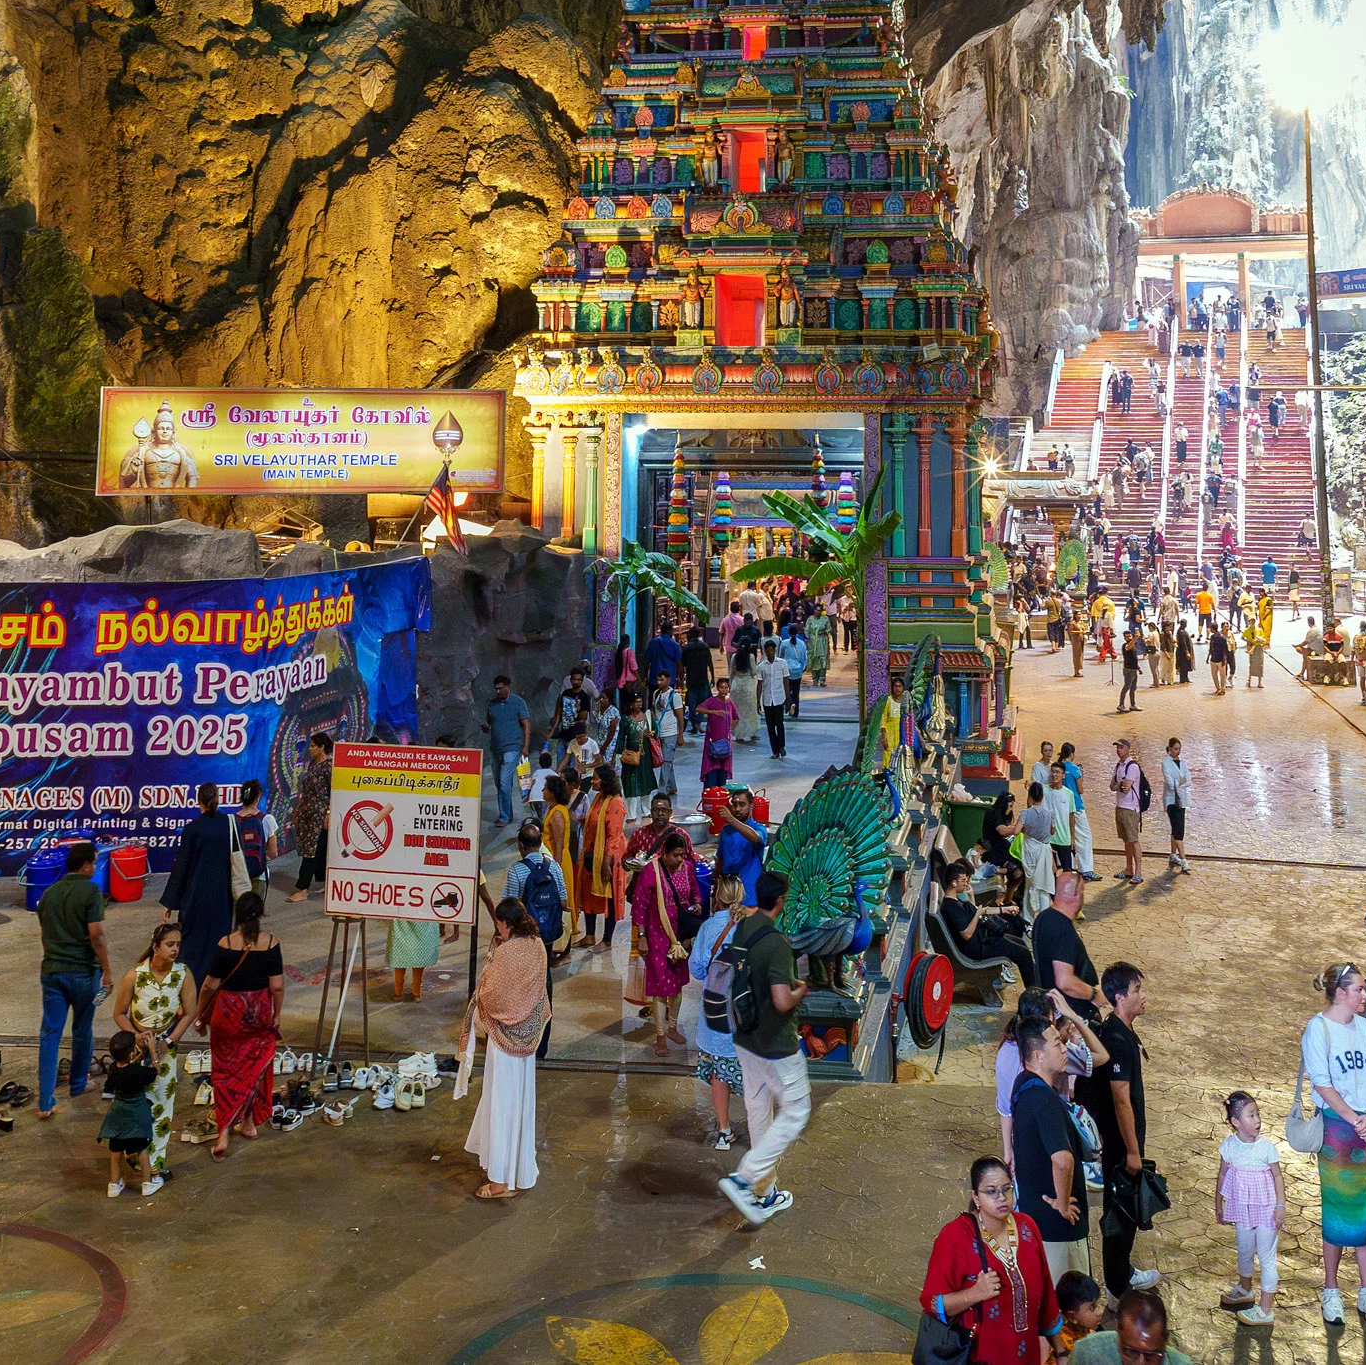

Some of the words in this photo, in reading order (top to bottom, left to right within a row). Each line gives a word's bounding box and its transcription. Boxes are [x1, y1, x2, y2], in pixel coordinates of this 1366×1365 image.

[182, 402, 216, 428] ஸ்ரீ
[351, 406, 432, 425] கோவில்
[214, 454, 237, 466] SRI
[242, 454, 337, 466] VELAYUTHAR
[342, 454, 397, 466] TEMPLE
[263, 469, 296, 480] (MAIN
[300, 469, 349, 480] TEMPLE)
[94, 582, 355, 655] நல்வாழ்த்துக்கள்
[194, 654, 327, 704] Perayaan
[146, 714, 249, 756] 2025
[347, 749, 371, 757] ANDA
[372, 751, 414, 760] MEMASUKI
[427, 754, 468, 762] KAWASAN
[364, 760, 408, 769] LARANGAN
[410, 762, 450, 771] MEROKOK
[90, 785, 133, 814] (M)
[418, 803, 438, 816] YOU
[441, 805, 460, 817] ARE
[33, 819, 77, 831] Digital
[83, 818, 137, 831] Printing
[141, 817, 151, 828] &
[350, 809, 361, 820] NO
[359, 820, 384, 852] SMOKING
[414, 818, 463, 832] ENTERING
[404, 834, 424, 847] NON
[425, 836, 471, 851] SMOKING
[423, 853, 449, 866] AREA
[331, 880, 354, 902] NO
[358, 882, 424, 907] SHOES
